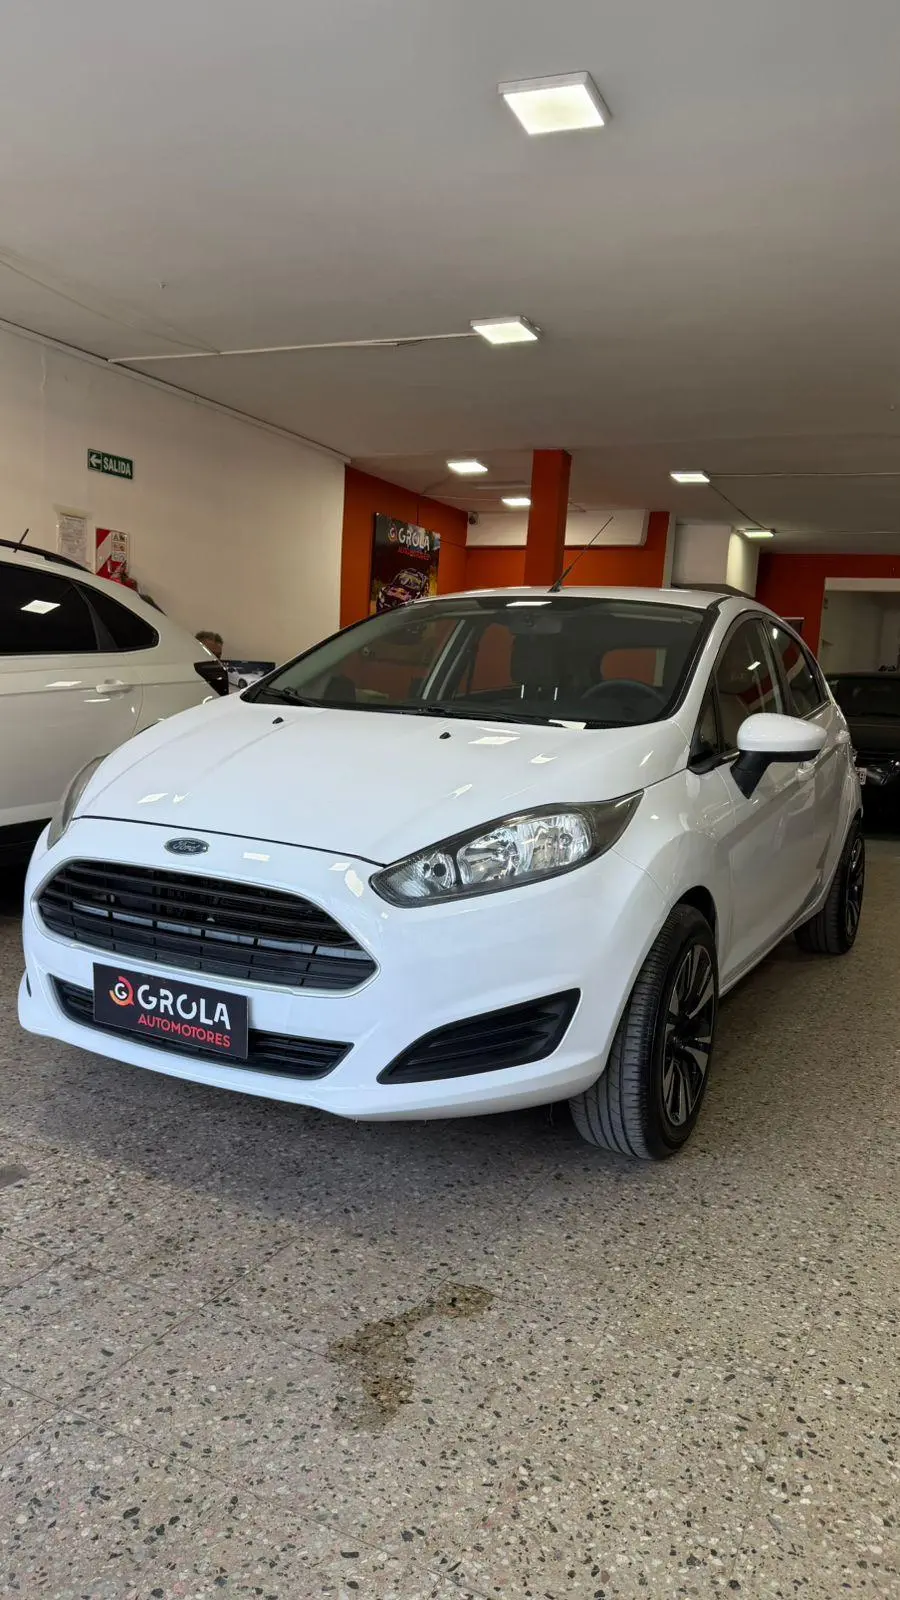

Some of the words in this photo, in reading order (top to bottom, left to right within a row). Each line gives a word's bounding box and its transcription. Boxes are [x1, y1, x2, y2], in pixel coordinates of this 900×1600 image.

[103, 456, 132, 476] SALIDA
[398, 527, 430, 551] GROLA
[172, 840, 201, 852] Ford
[137, 984, 231, 1030] GROLA
[138, 1013, 231, 1048] AUTOMOTORES
